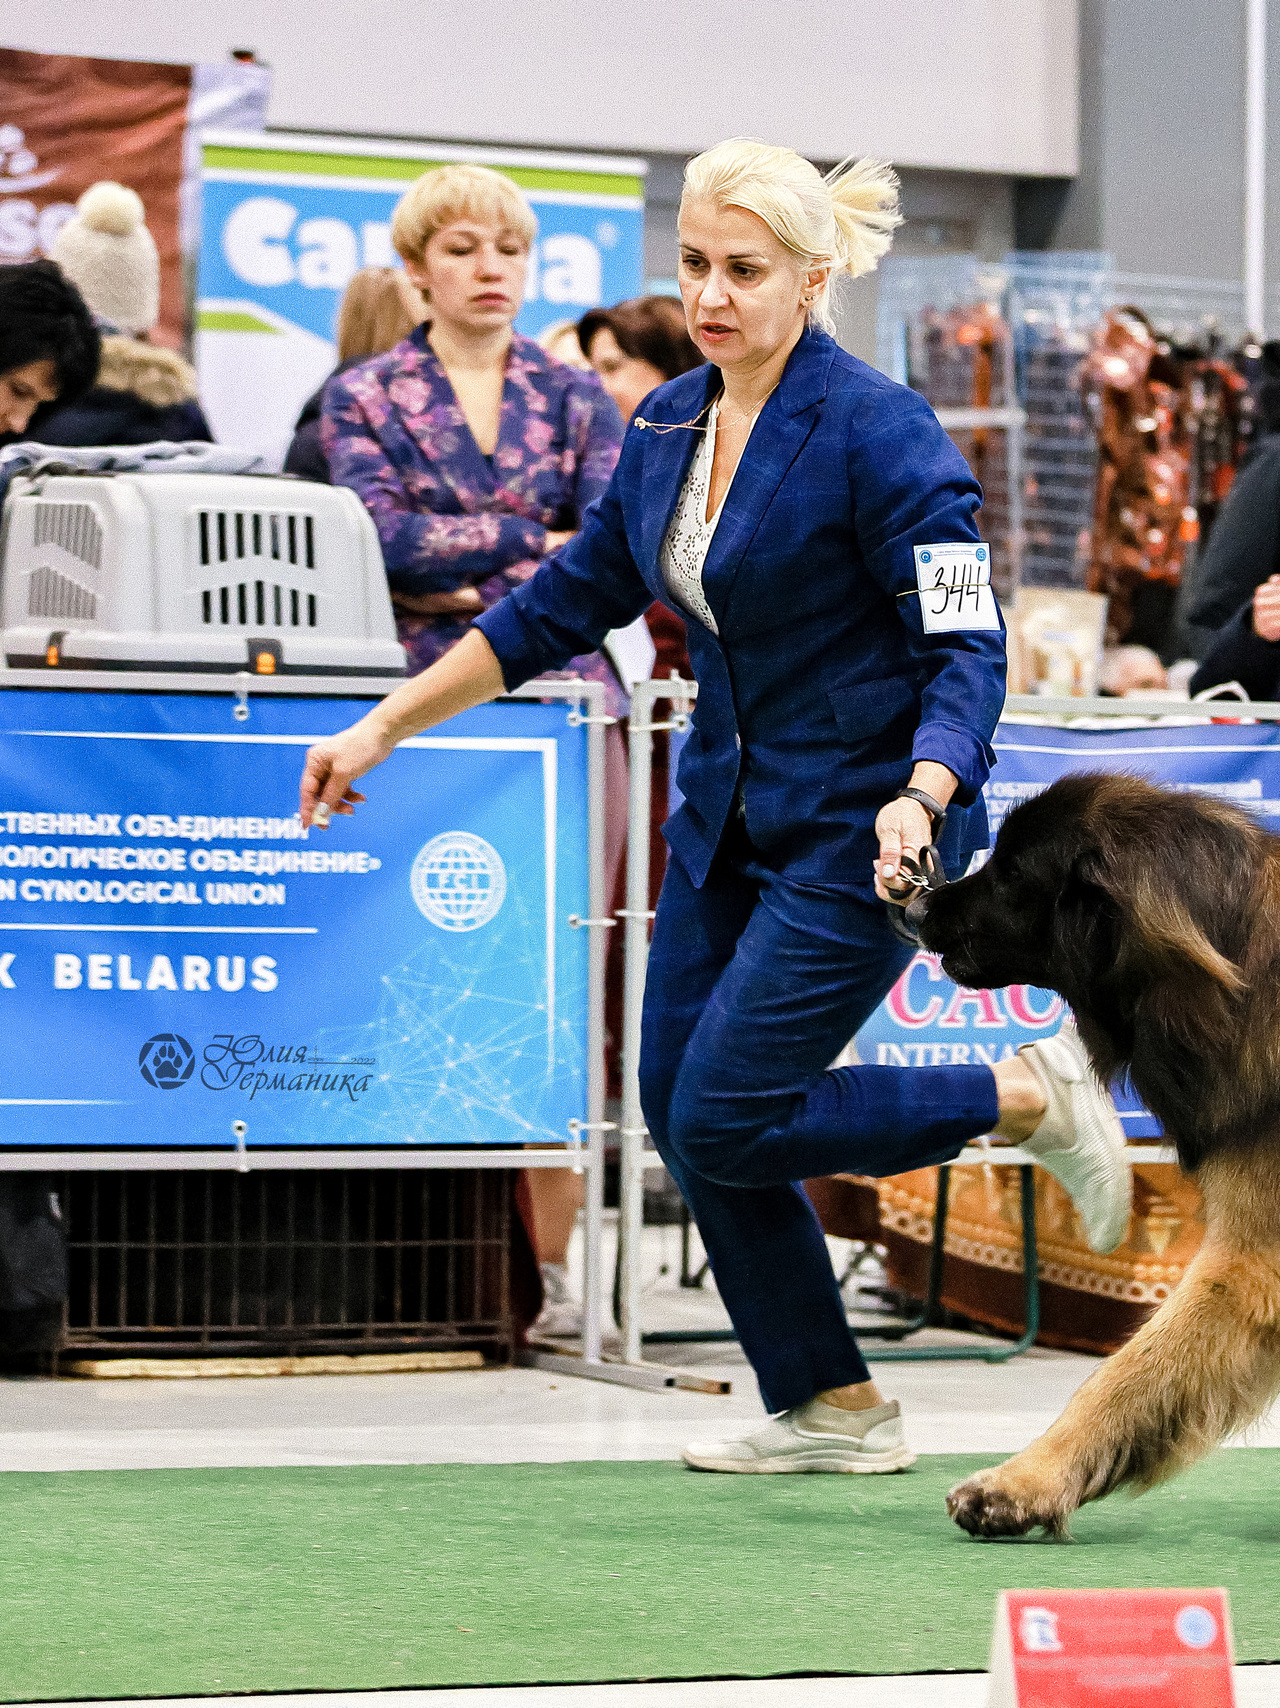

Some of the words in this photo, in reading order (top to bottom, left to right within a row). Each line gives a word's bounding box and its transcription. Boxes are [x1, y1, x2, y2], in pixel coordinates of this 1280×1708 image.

[931, 563, 981, 614] 344
[0, 845, 187, 871] ОЛОГИЧЕСКОЕ
[20, 878, 202, 904] CYNOLOGICAL
[205, 882, 286, 905] UNION
[54, 953, 279, 992] BELARUS
